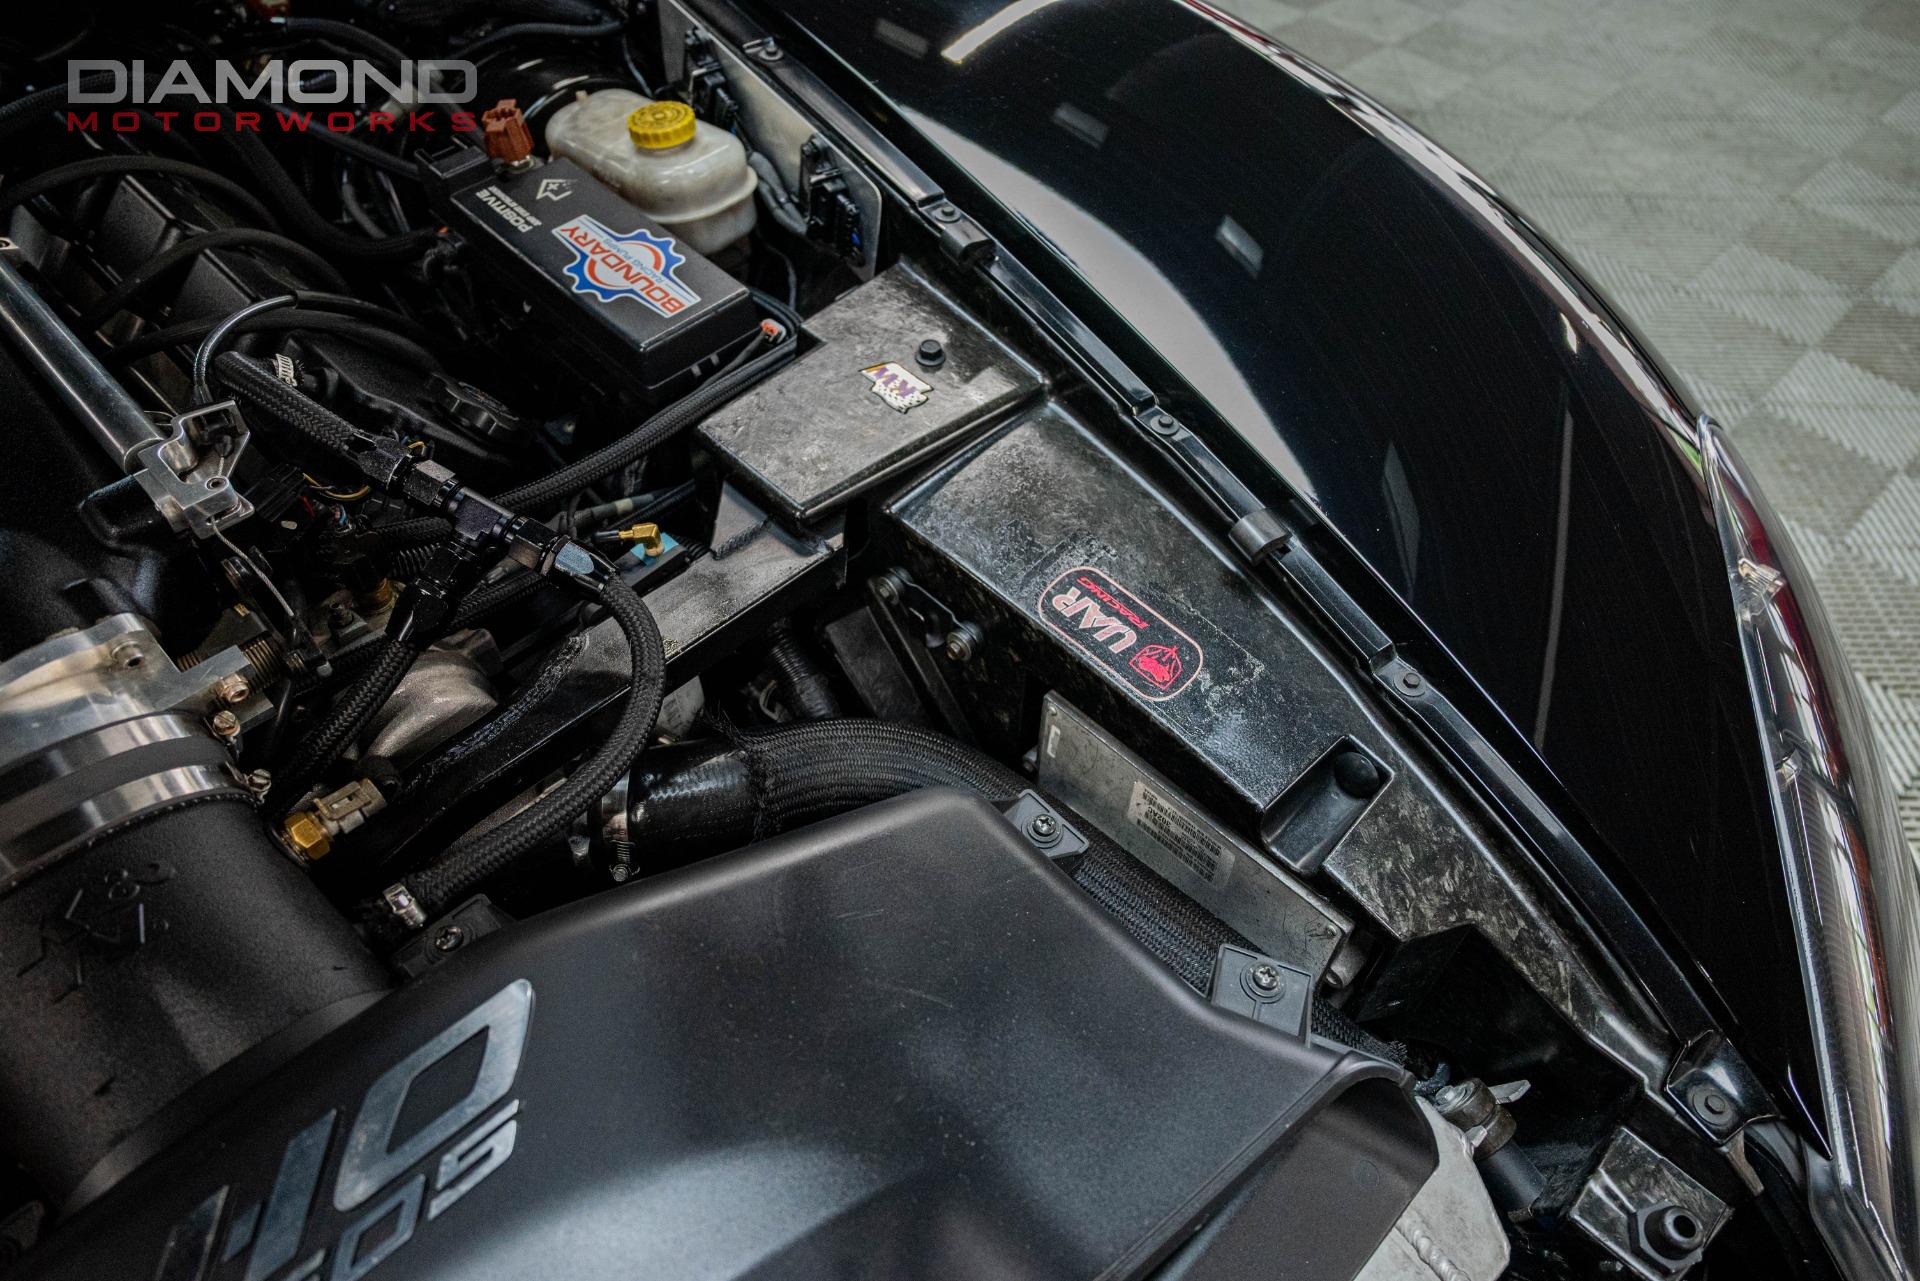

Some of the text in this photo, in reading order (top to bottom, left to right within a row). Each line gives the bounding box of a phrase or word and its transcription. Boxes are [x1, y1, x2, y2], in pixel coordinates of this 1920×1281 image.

[475, 188, 536, 233] POSITIVE
[561, 225, 687, 314] BOUNDARY
[630, 258, 664, 284] RACING
[1052, 586, 1138, 654] UAR
[1076, 575, 1151, 630] RACING
